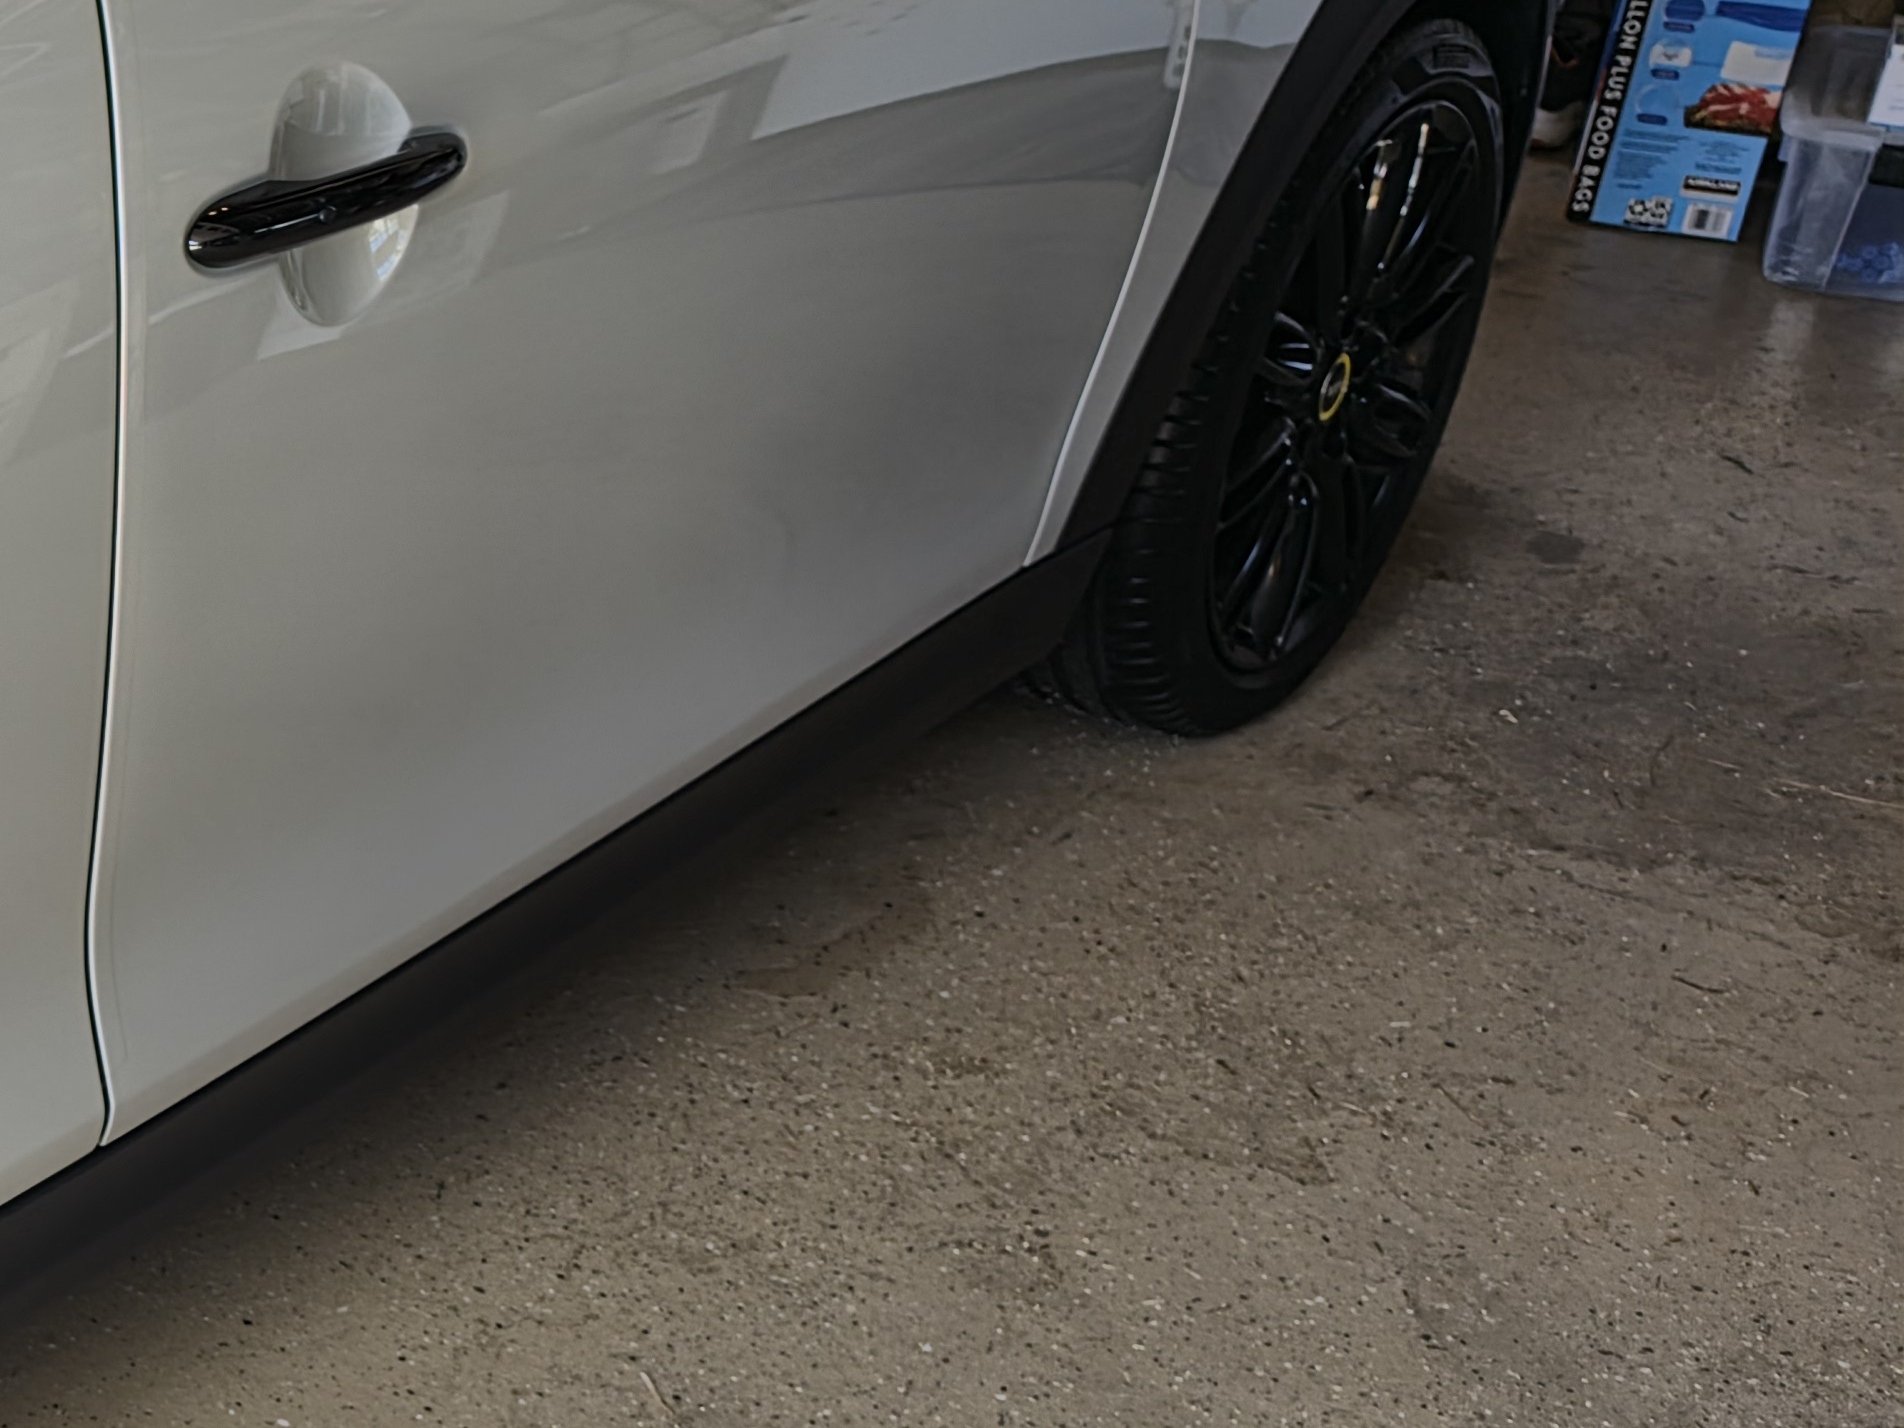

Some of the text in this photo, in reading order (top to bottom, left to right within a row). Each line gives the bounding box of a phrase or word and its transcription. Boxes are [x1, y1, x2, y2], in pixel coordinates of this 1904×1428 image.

[1602, 53, 1633, 101] PLUS
[1587, 103, 1618, 162] FOOD
[1571, 163, 1601, 213] BAGS
